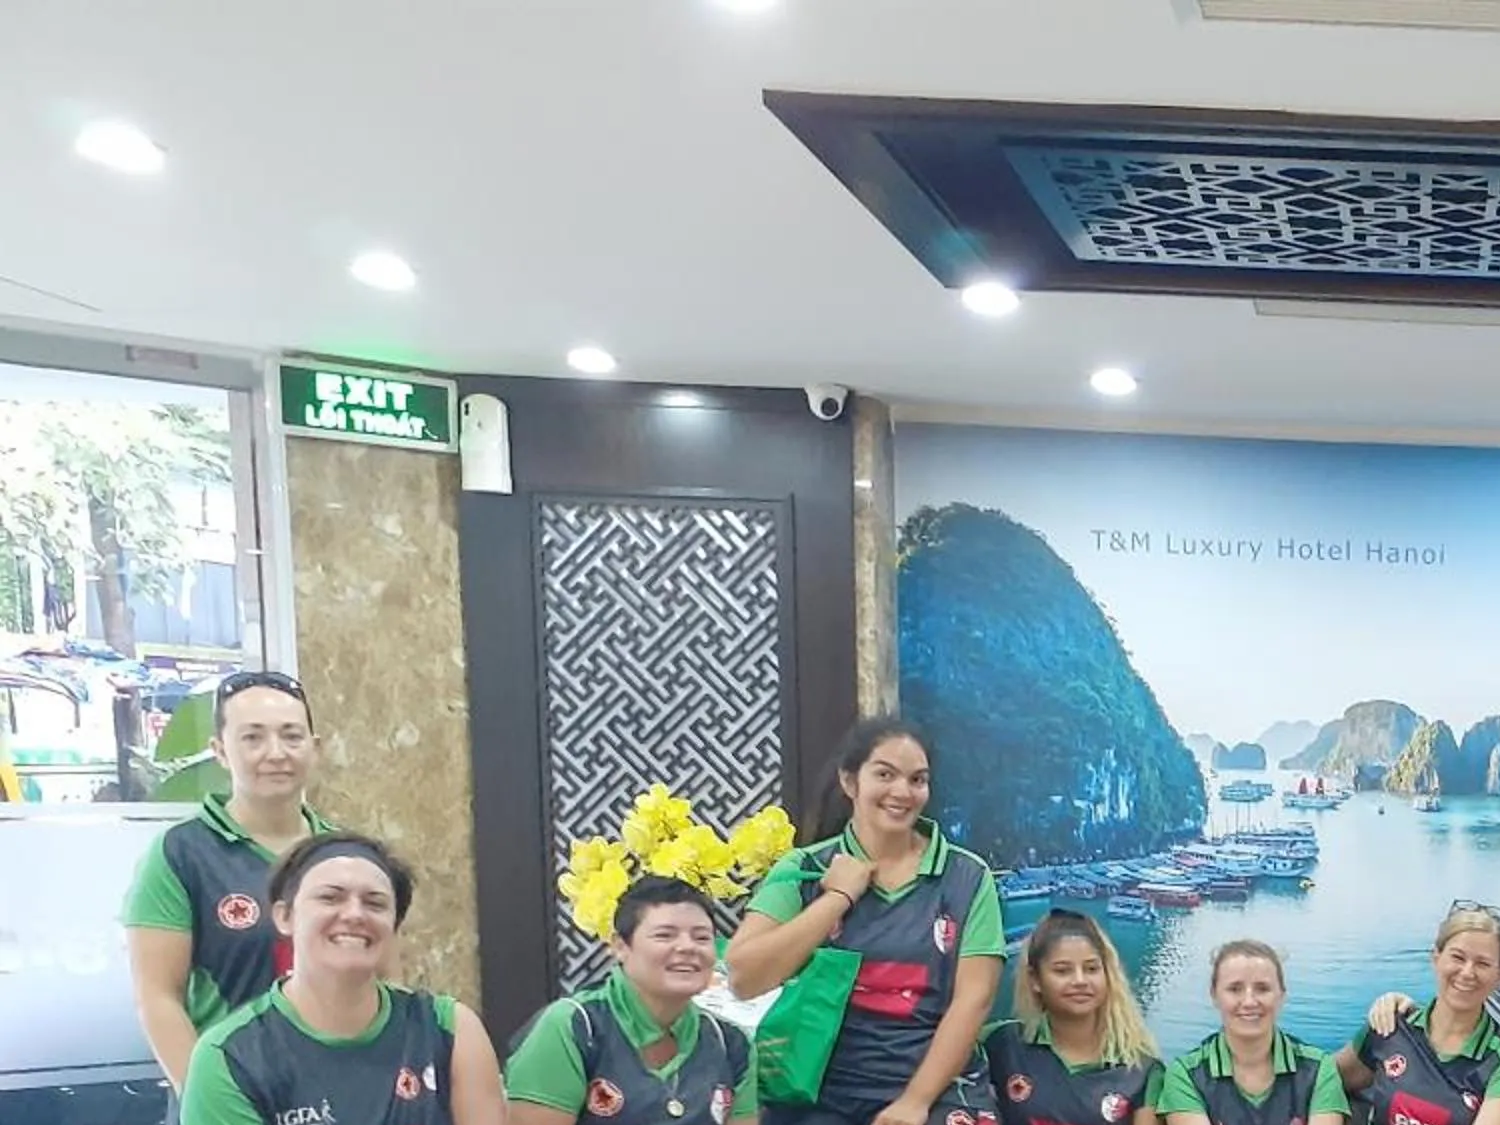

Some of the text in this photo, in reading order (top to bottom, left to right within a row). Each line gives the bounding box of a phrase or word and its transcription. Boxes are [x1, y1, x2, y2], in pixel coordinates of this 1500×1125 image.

[315, 372, 414, 410] EXIT
[1090, 529, 1445, 565] T&M Luxury Hotel Hanoi
